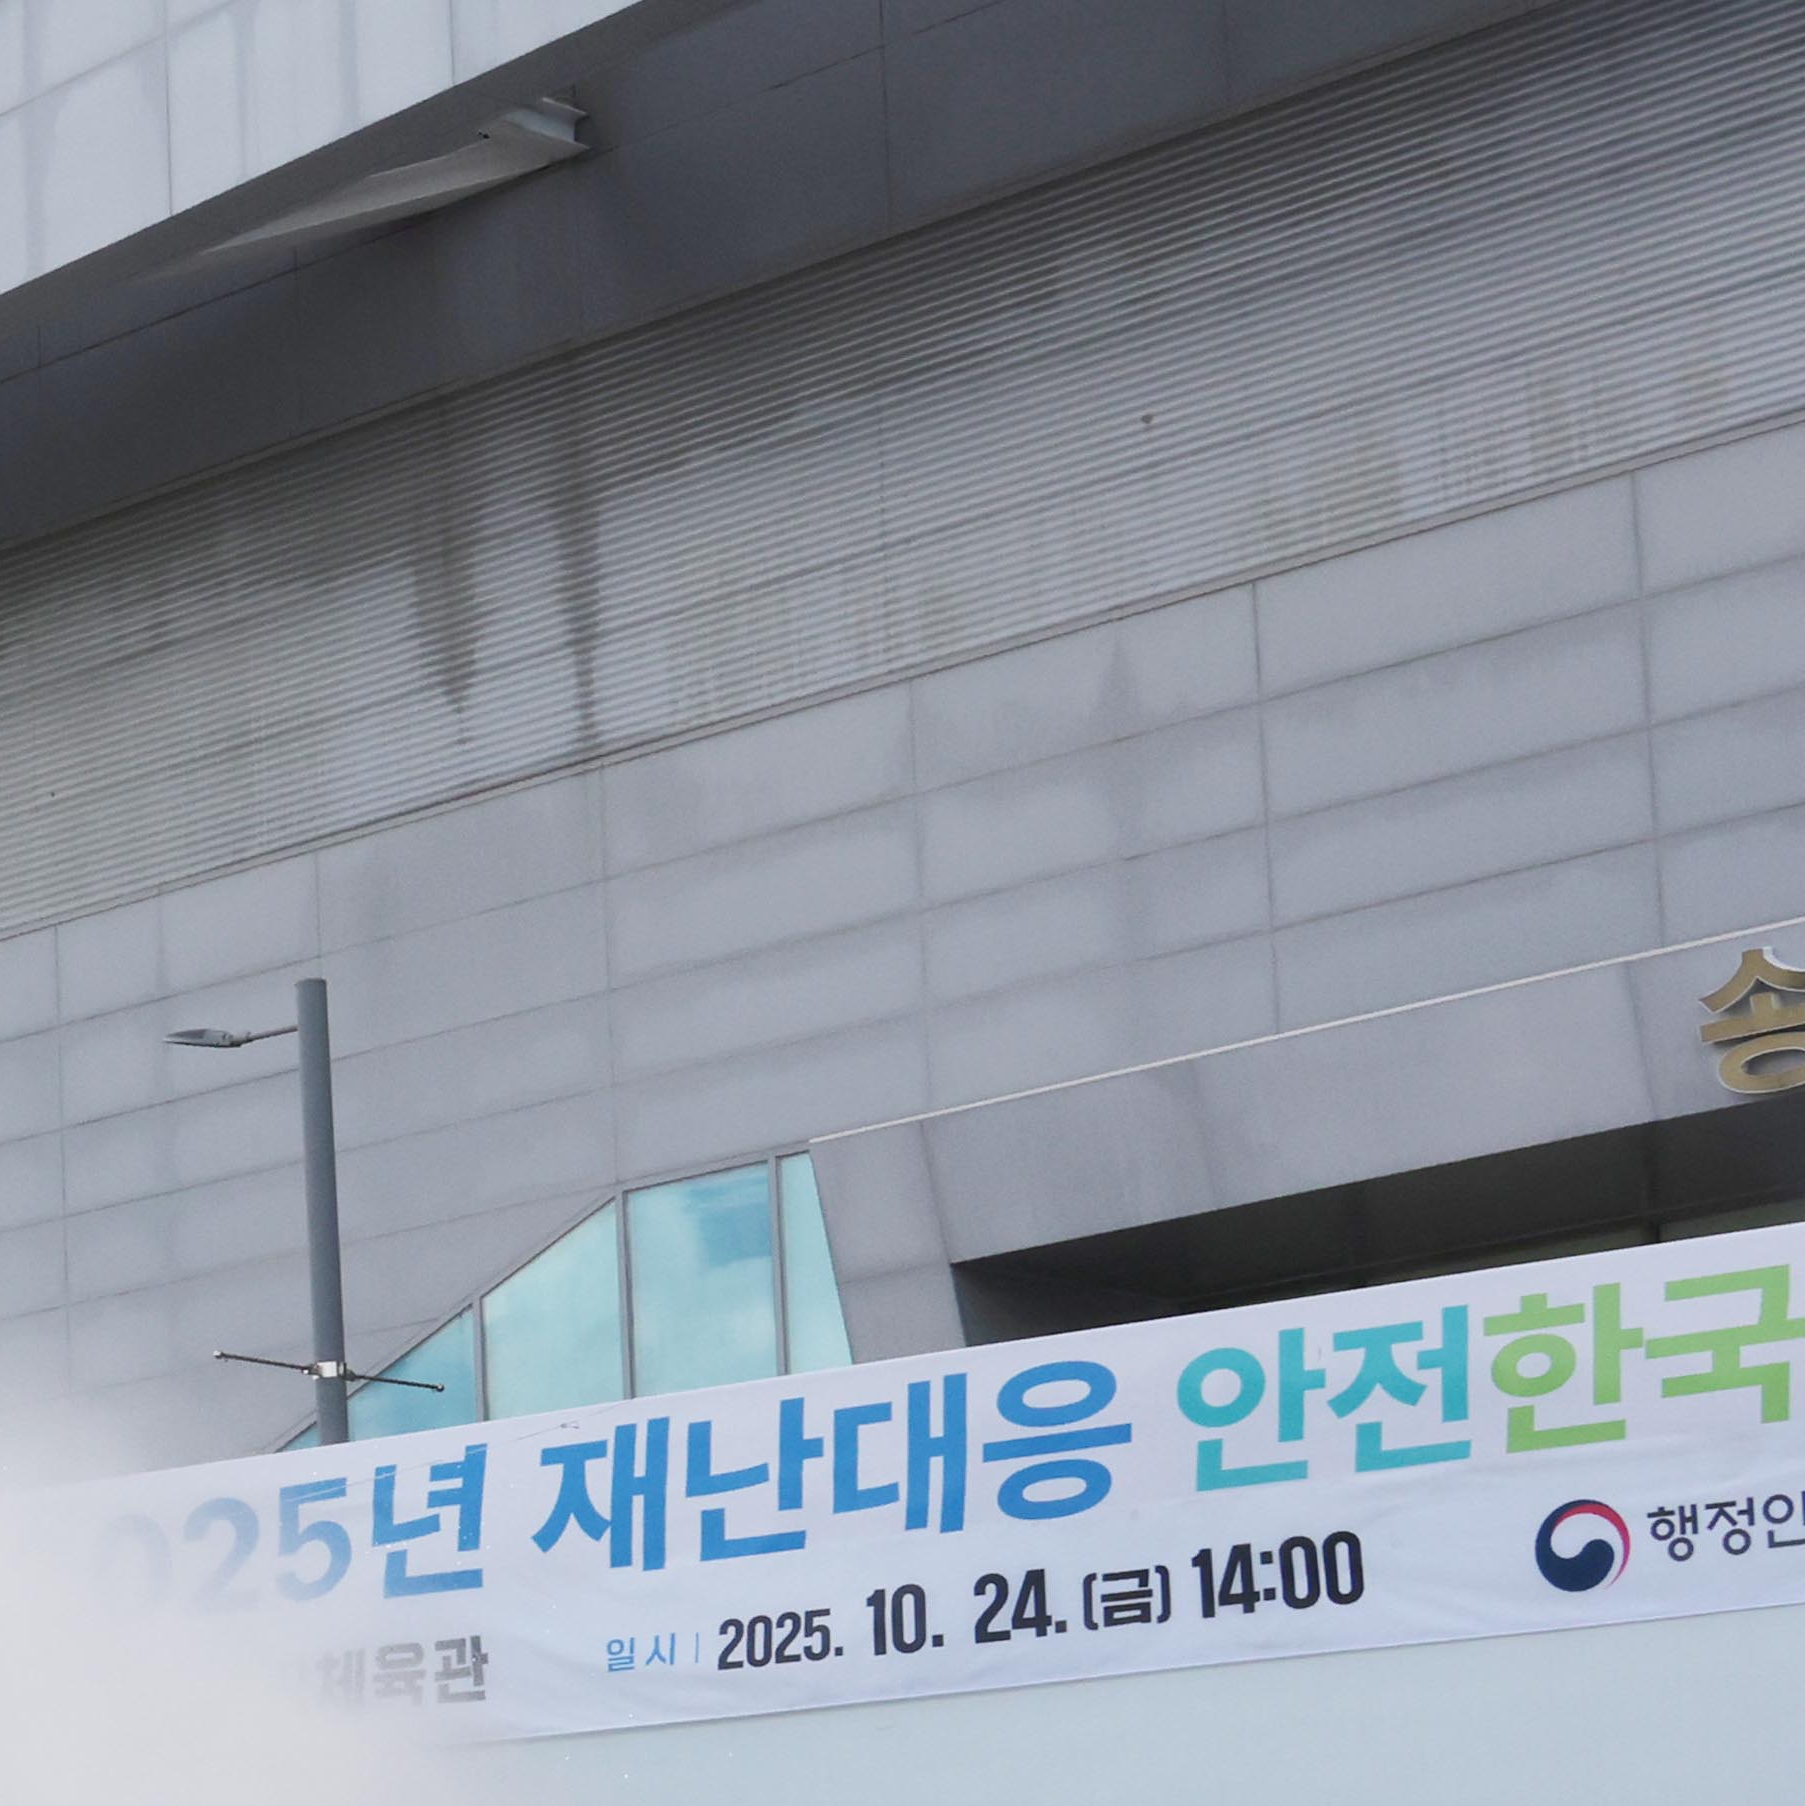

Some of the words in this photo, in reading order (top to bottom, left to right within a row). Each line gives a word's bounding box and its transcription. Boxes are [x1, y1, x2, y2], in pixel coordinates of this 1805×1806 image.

[531, 1360, 1133, 1572] 재난대응
[1176, 1264, 1805, 1492] 안전한국
[716, 1607, 845, 1672] 2025.
[865, 1583, 945, 1657] 10.
[1191, 1530, 1365, 1619] 14:00
